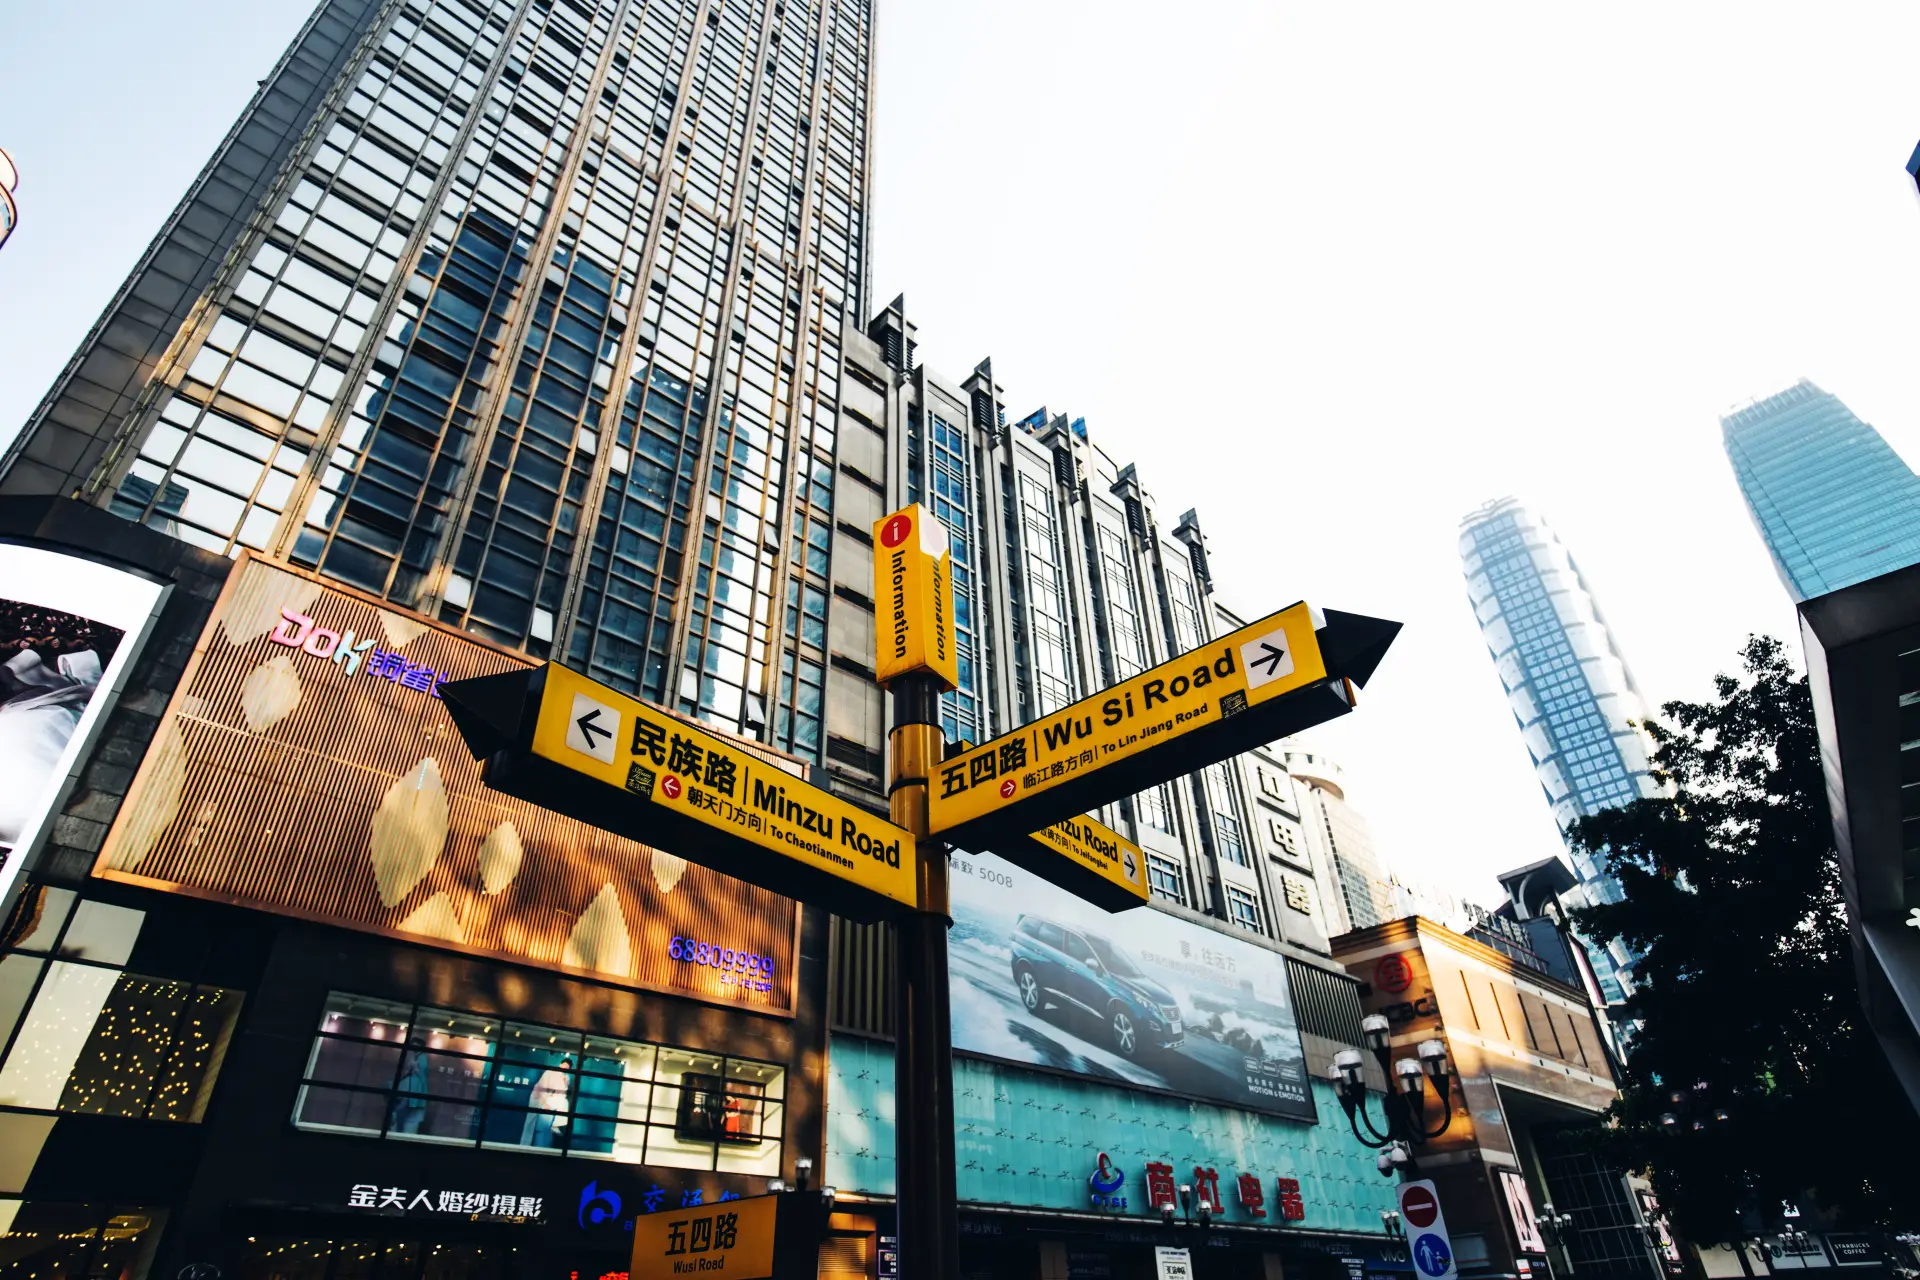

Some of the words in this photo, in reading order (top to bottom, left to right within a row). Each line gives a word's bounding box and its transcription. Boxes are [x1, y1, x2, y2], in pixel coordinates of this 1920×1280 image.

[891, 549, 909, 659] Information
[932, 556, 946, 661] nformation
[270, 606, 377, 677] DOK
[1043, 715, 1093, 752] Wu
[1102, 691, 1135, 727] Si
[1143, 647, 1237, 710] Road
[1101, 743, 1116, 756] To
[1119, 734, 1137, 749] Lin
[1139, 718, 1173, 741] Jiang
[1175, 702, 1209, 725] Road
[630, 716, 737, 799] 民族路
[941, 737, 1027, 801] 五四路
[1022, 750, 1094, 790] 临江路方向
[687, 786, 762, 833] 朝天门方向
[753, 777, 833, 840] Minzu
[841, 815, 900, 870] Road
[770, 824, 784, 840] To
[785, 831, 854, 870] Chaotianmen
[1072, 844, 1080, 855] To
[1083, 824, 1119, 863] Road
[979, 867, 1013, 889] 5008
[669, 936, 775, 979] 68809999
[1248, 1084, 1273, 1097] MOTION
[1278, 1091, 1306, 1103] EMOTION
[347, 1183, 544, 1218] 金夫人婚纱摄影
[1144, 1161, 1305, 1221] 商社电器
[664, 1211, 739, 1256] 五四路
[1833, 1241, 1871, 1250] STARBUCKS
[673, 1259, 698, 1275] Wusi
[698, 1255, 725, 1272] Road
